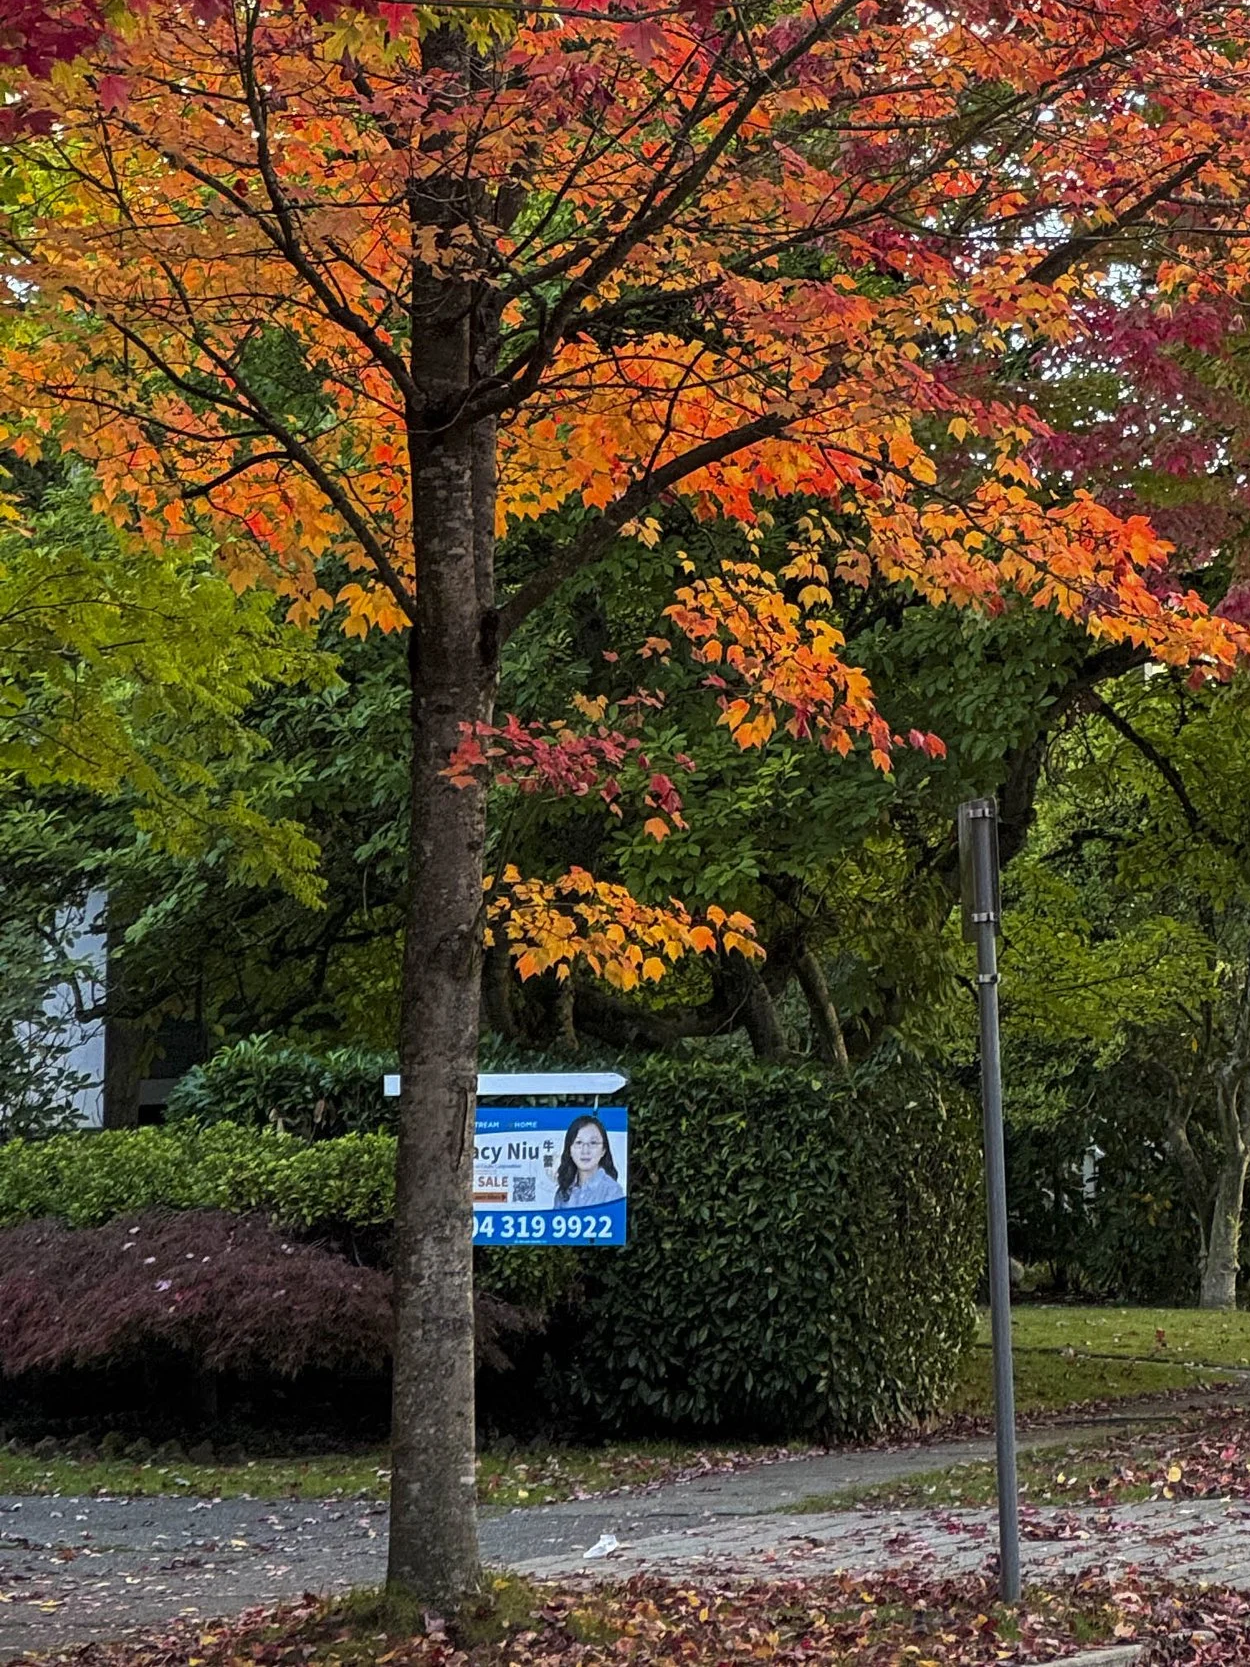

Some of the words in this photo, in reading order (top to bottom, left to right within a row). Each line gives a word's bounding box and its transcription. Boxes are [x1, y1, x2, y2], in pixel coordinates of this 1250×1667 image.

[514, 1121, 538, 1129] HOME
[473, 1145, 502, 1164] acy
[507, 1141, 539, 1160] Niu
[478, 1176, 509, 1187] SALE
[500, 1215, 546, 1238] 319
[551, 1215, 613, 1238] 9922
